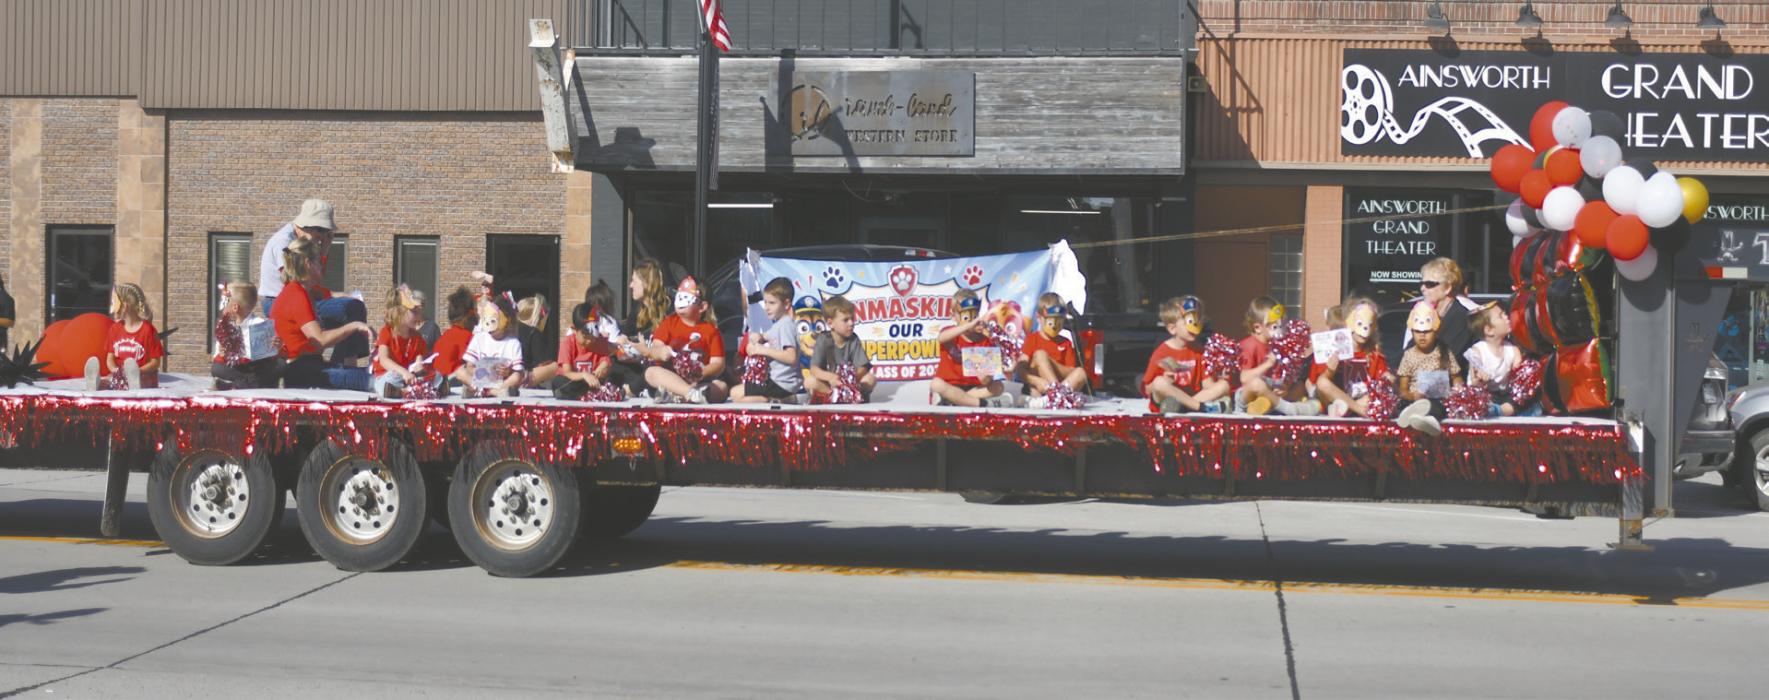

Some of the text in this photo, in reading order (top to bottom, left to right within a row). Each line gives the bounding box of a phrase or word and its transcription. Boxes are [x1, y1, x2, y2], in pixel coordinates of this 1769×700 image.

[1398, 63, 1753, 100] AINSWORTH GRAND
[914, 129, 958, 142] STORE
[1624, 112, 1769, 149] EATER
[1357, 200, 1447, 214] AINSWORTH
[1372, 220, 1430, 235] GRAND
[1365, 240, 1437, 256] THEATER
[1370, 270, 1423, 279] NOW SHOWIN
[889, 322, 924, 338] OUR
[901, 365, 917, 379] OF
